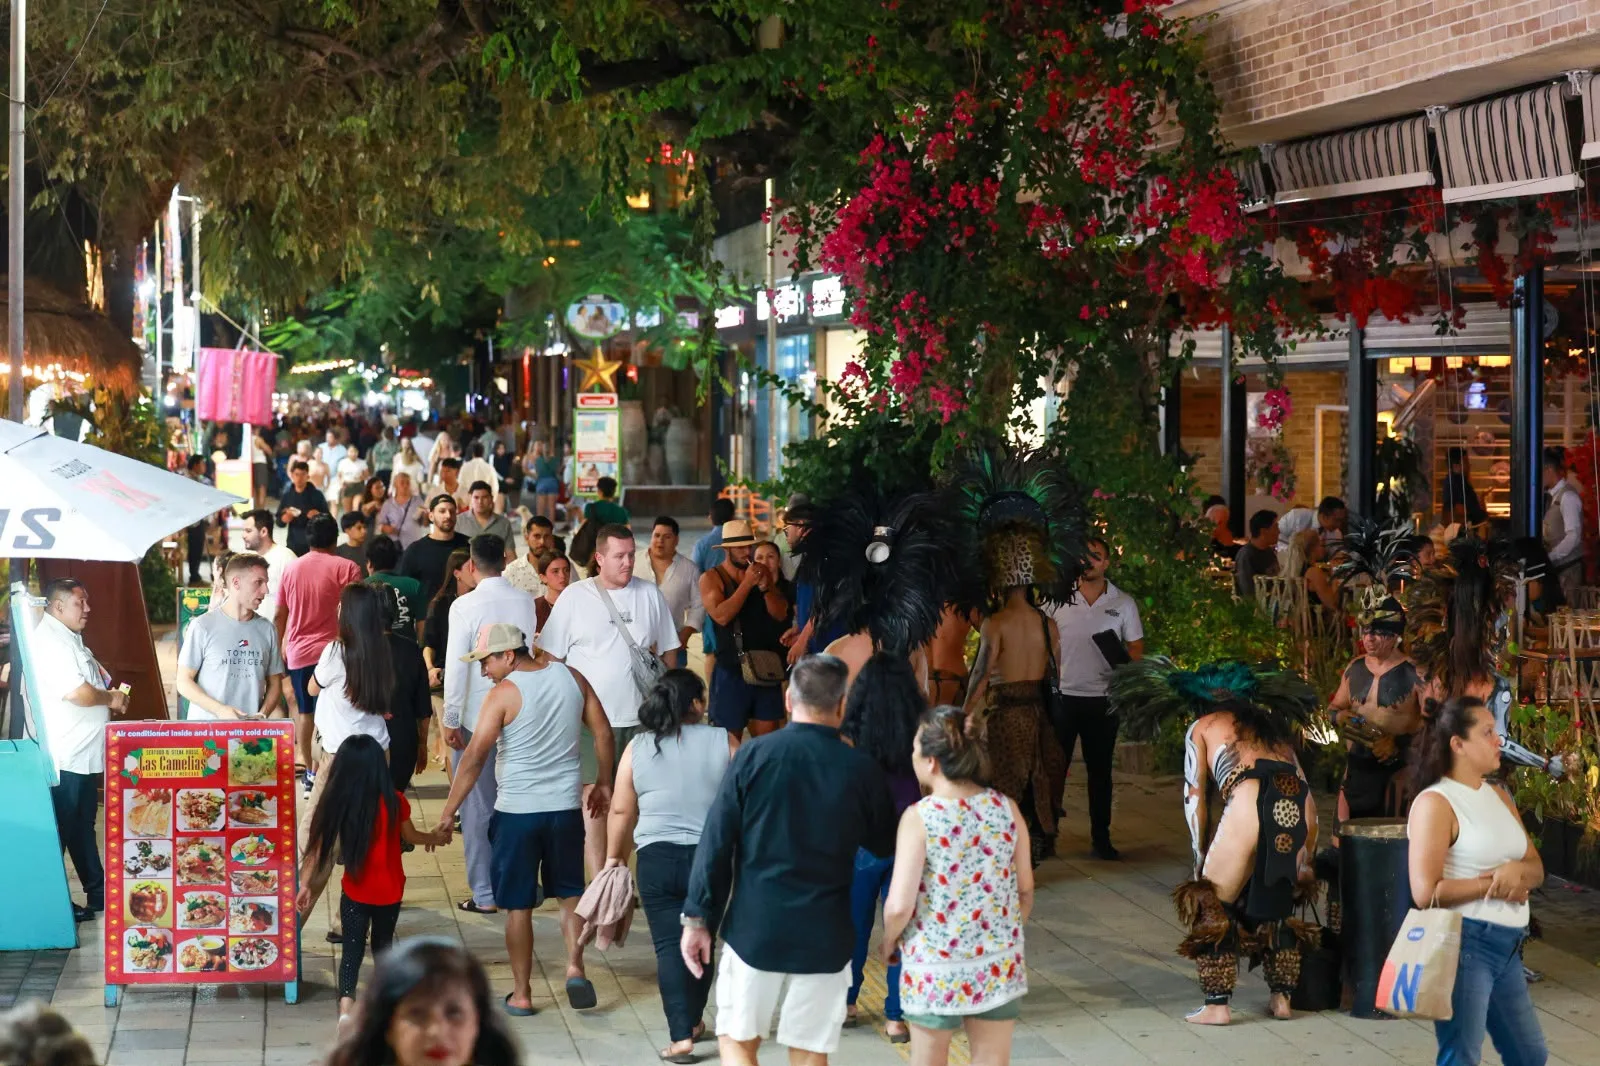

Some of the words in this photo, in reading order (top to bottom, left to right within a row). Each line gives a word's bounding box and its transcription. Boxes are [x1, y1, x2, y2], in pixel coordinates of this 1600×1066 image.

[226, 649, 261, 657] TOMMY
[127, 729, 170, 738] conditioned
[194, 729, 208, 737] and
[215, 729, 228, 737] bar
[229, 728, 245, 736] with
[245, 728, 261, 736] cold
[262, 728, 285, 736] drinks
[140, 755, 157, 771] Las
[159, 755, 206, 771] Camelias
[1392, 961, 1424, 1013] N
